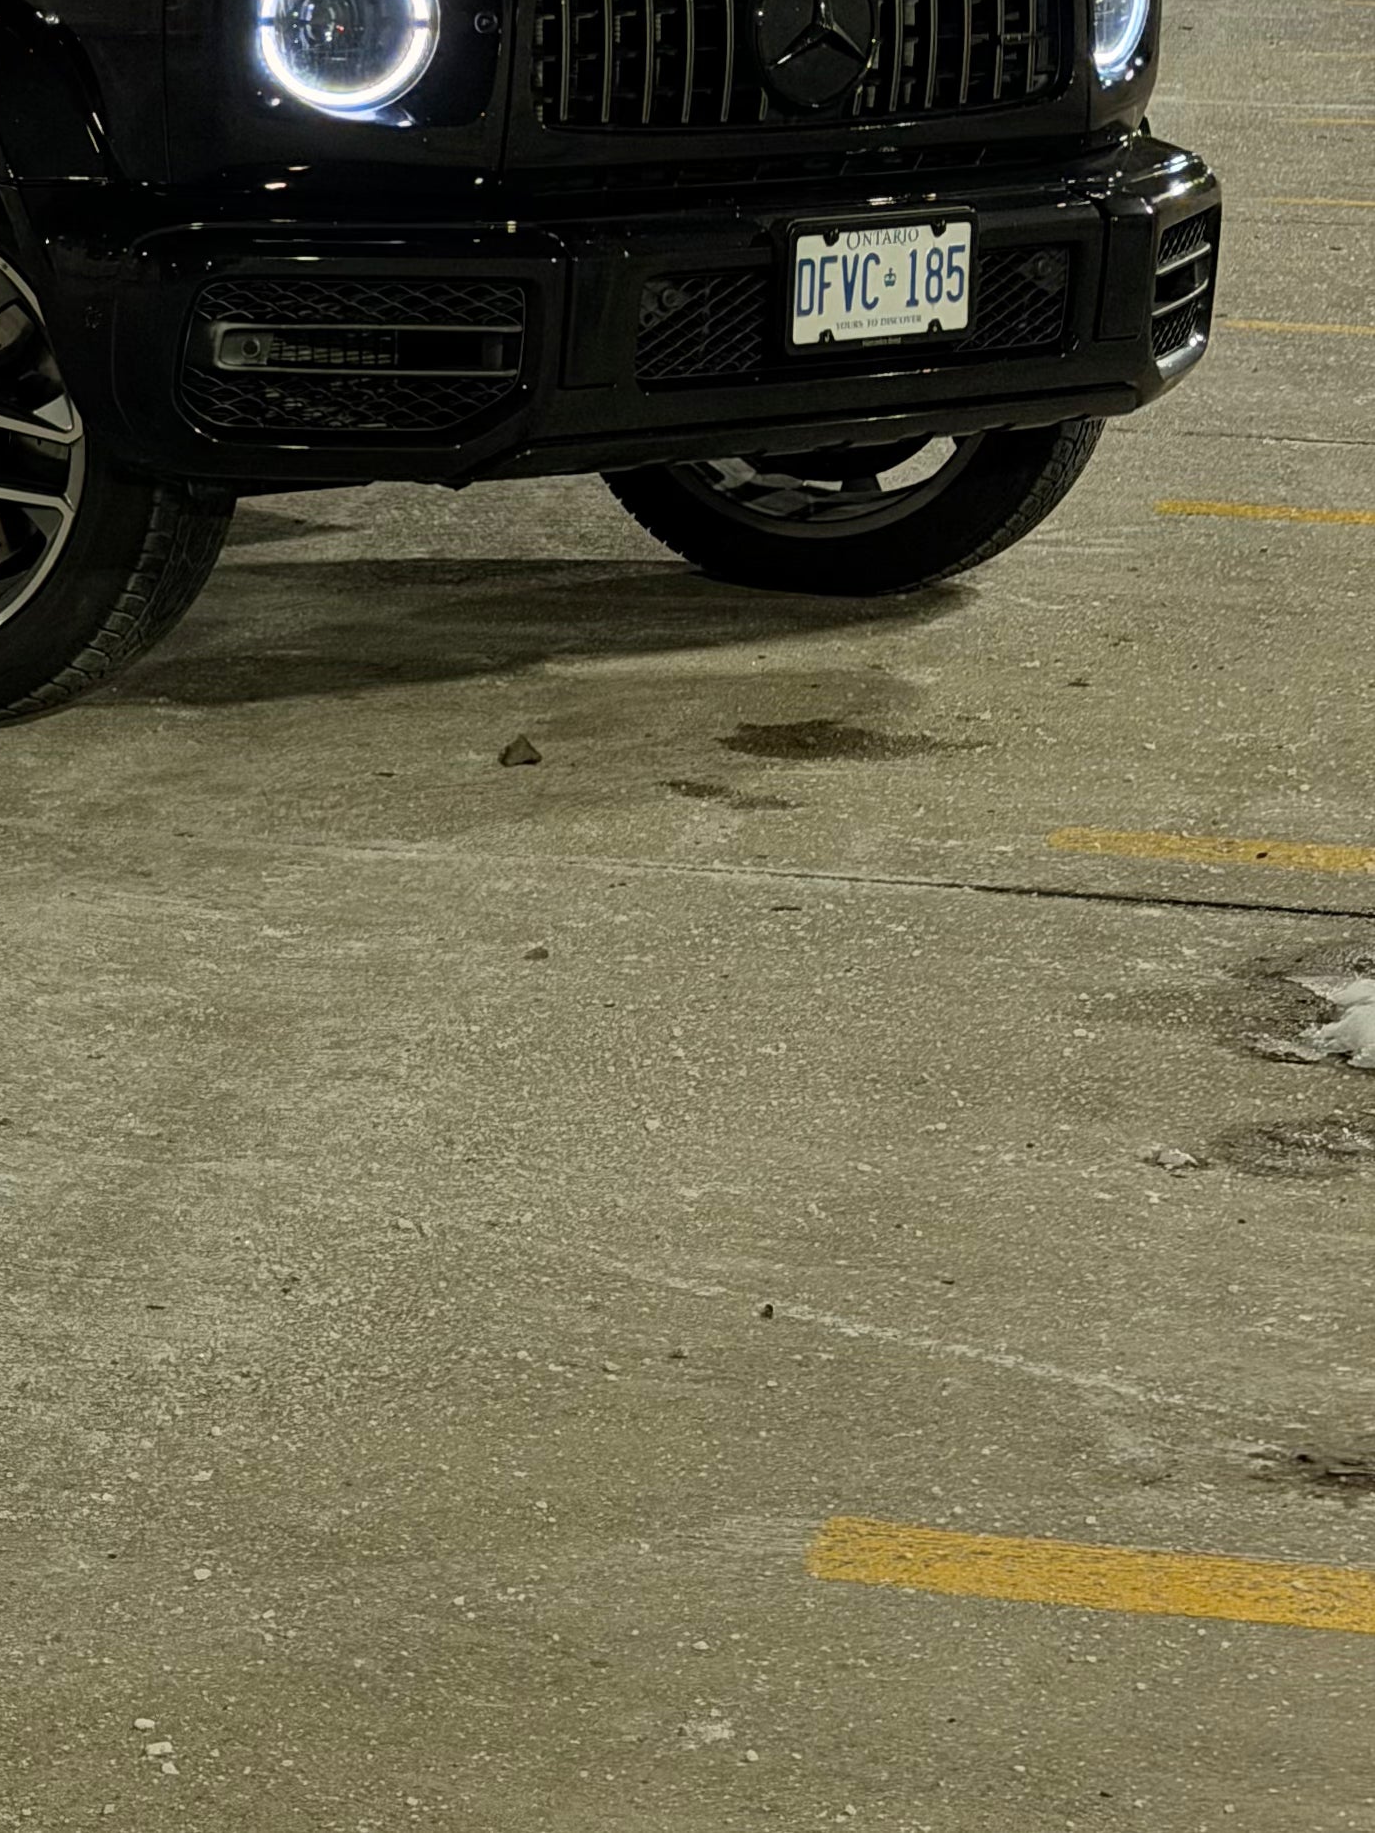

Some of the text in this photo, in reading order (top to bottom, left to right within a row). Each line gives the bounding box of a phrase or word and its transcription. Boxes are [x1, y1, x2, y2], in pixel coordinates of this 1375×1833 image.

[846, 228, 920, 250] ONTARIO
[797, 244, 967, 317] DFVC 185
[836, 314, 922, 331] YOURS TO DISCOVER
